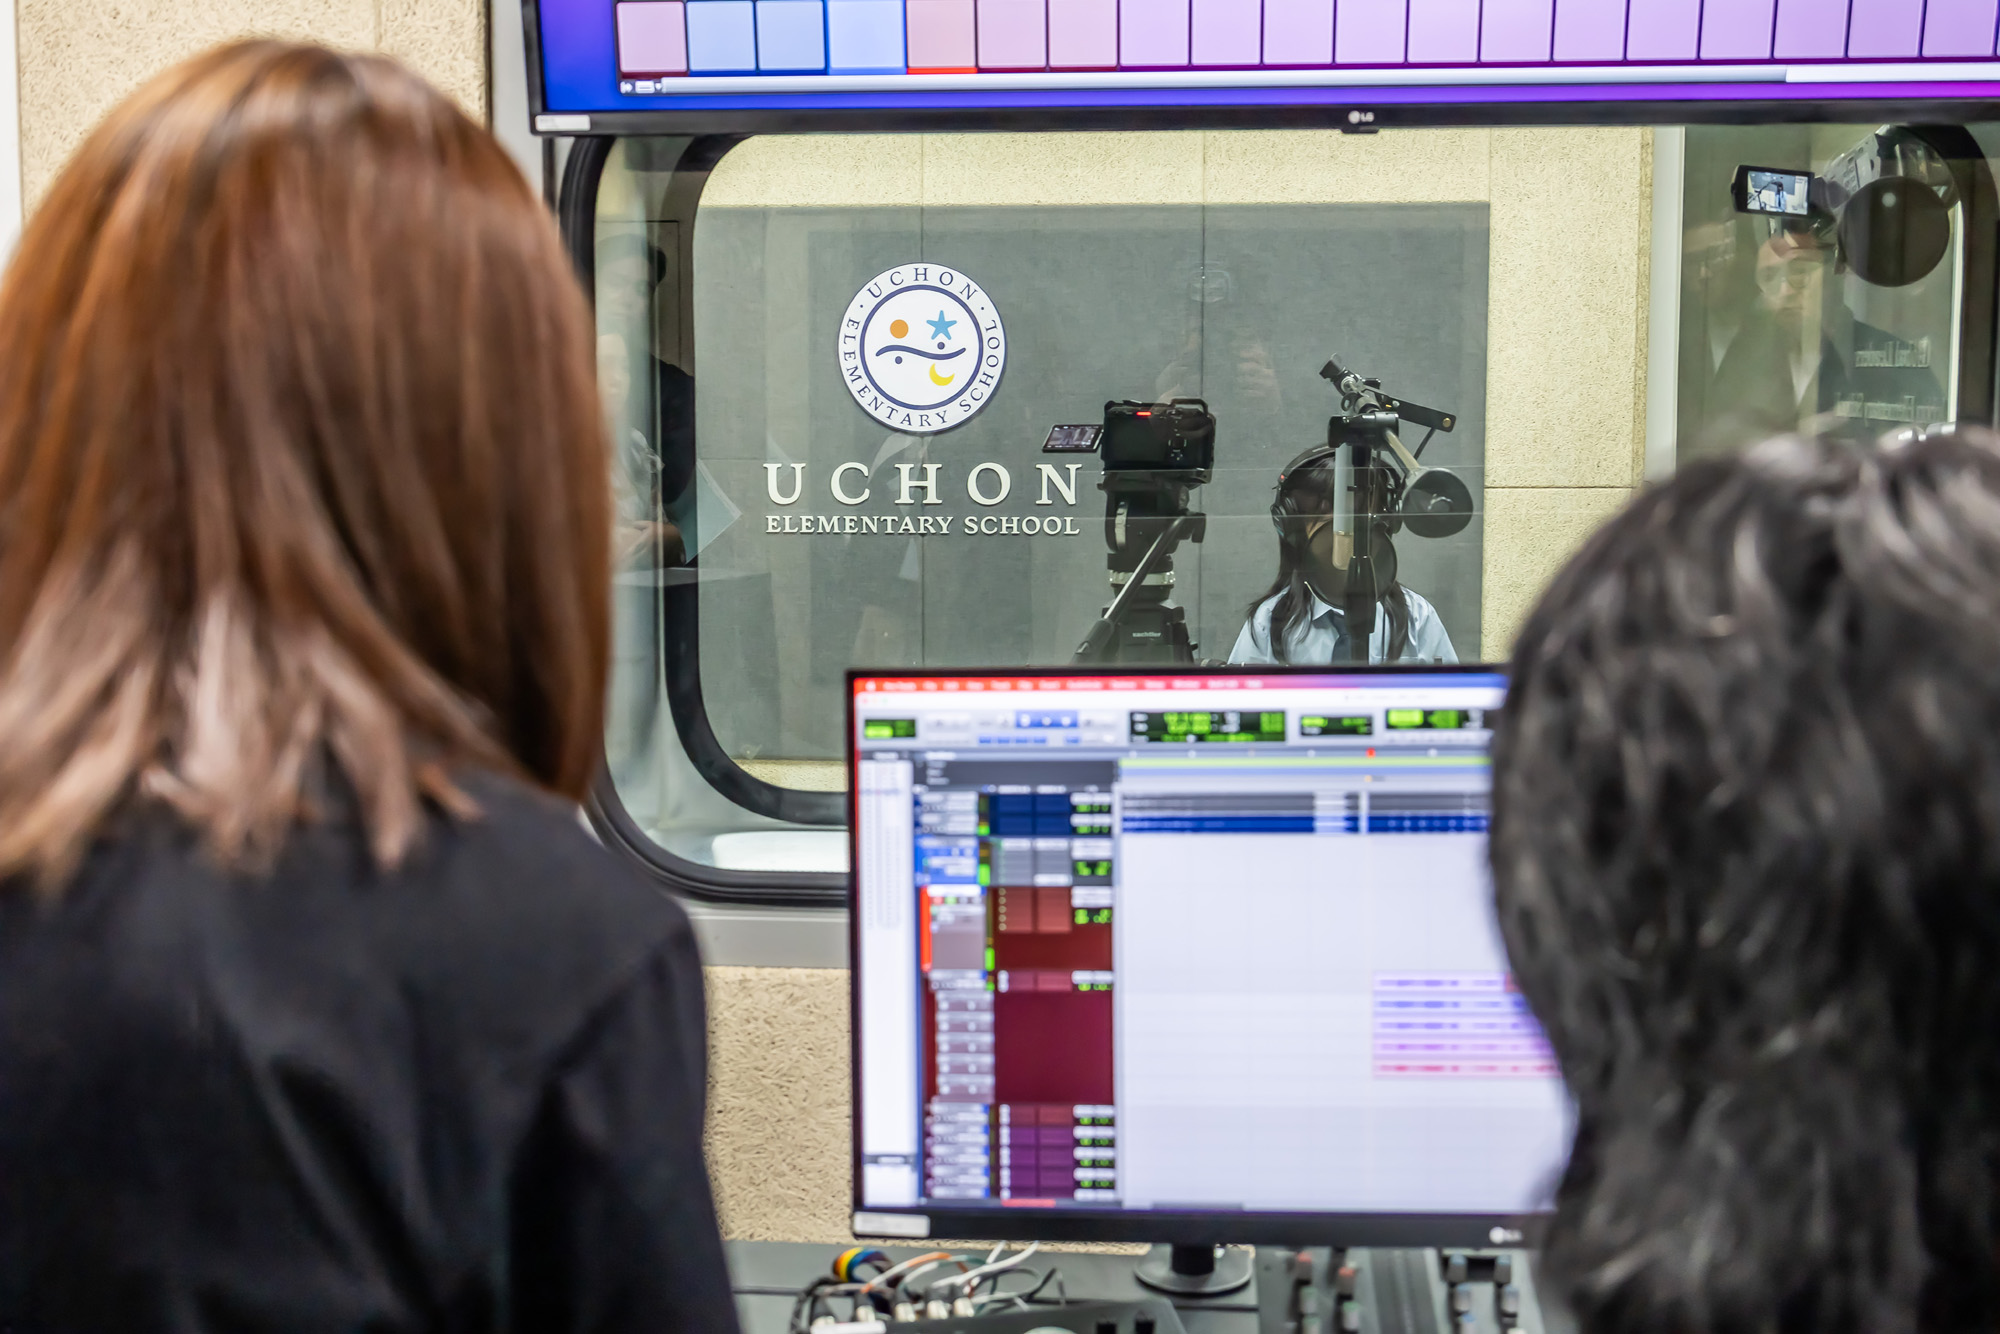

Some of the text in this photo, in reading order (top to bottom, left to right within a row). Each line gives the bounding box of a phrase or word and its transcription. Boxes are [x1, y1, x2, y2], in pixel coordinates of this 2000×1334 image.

[866, 267, 979, 301] UCHON
[843, 318, 1001, 428] ELEMENTARY SCHOOL
[763, 461, 1083, 505] UCHON
[765, 515, 1080, 535] ELEMENTARY SCHOOL
